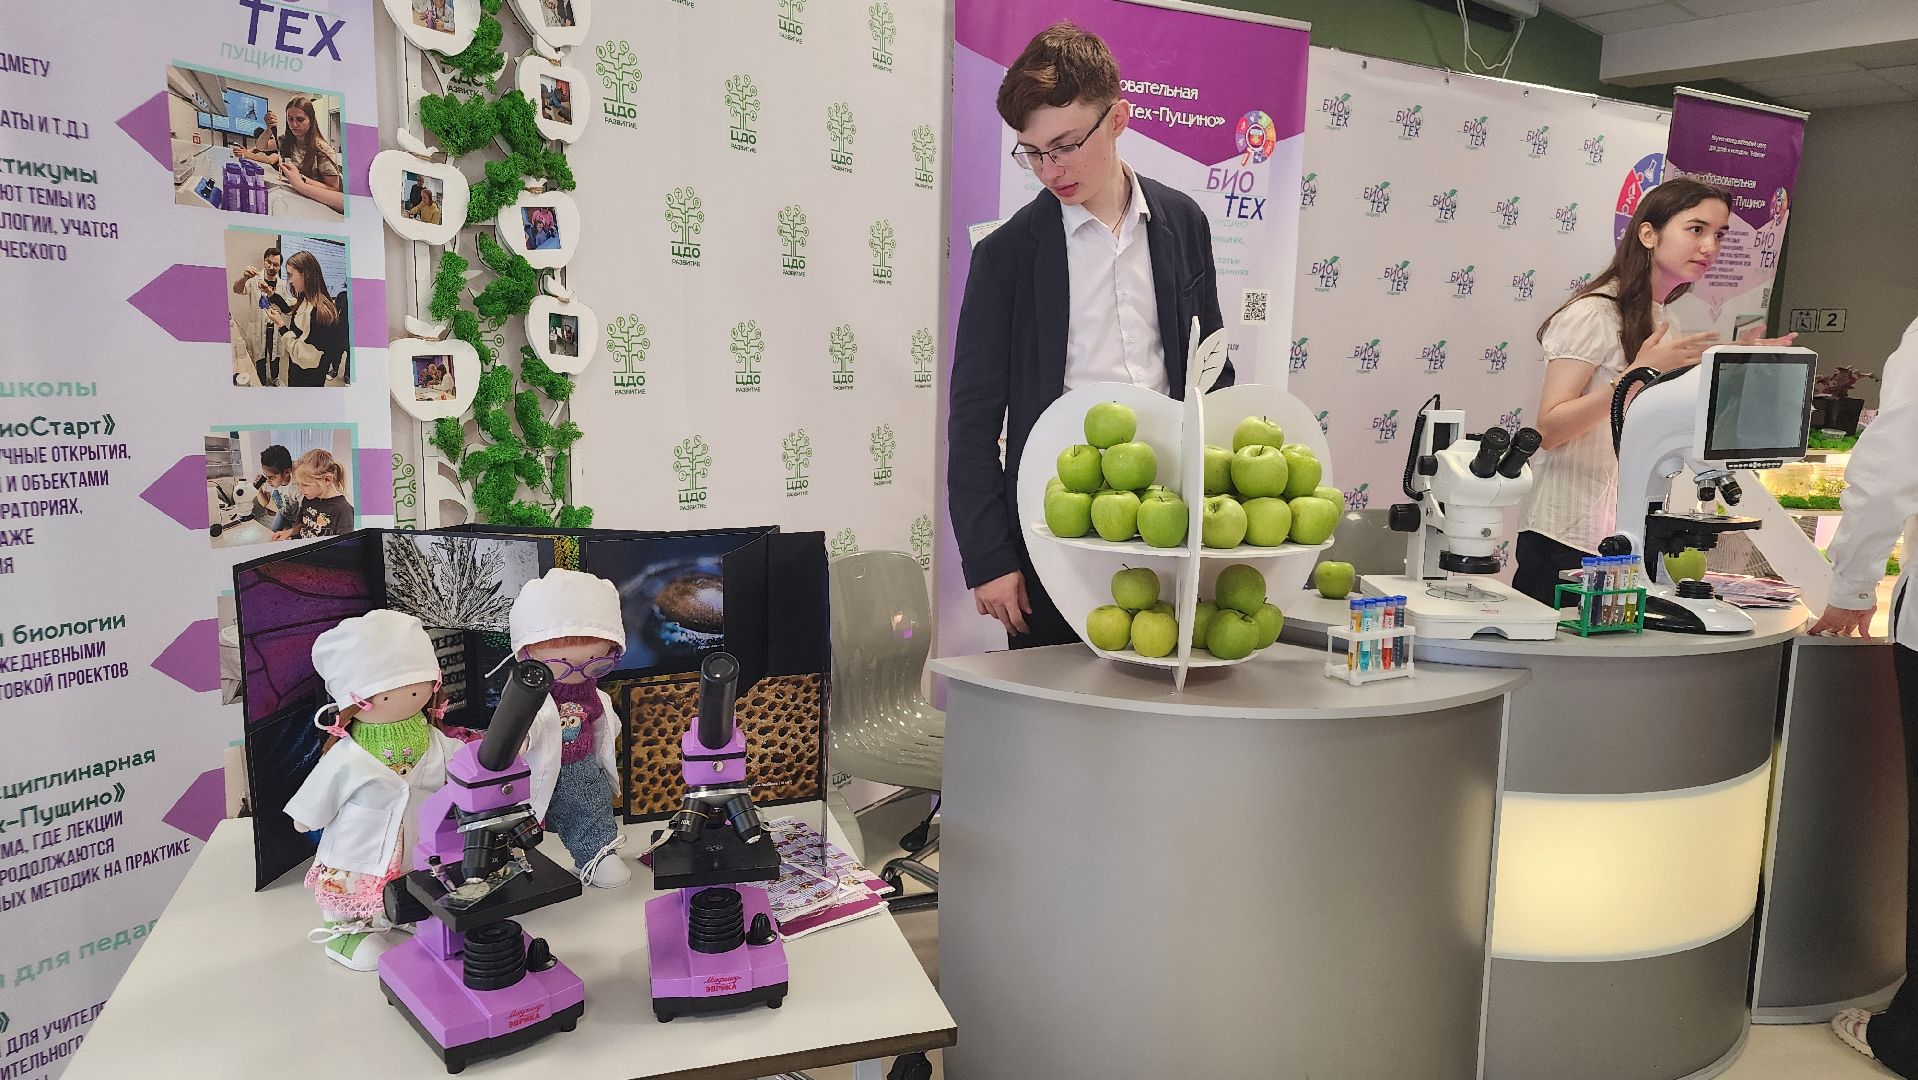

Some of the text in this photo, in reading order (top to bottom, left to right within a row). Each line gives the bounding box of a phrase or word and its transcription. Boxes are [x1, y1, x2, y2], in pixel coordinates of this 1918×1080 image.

[239, 0, 346, 62] ТЕХ
[778, 19, 803, 36] ЦДО
[220, 42, 303, 73] ПУЩИНО
[872, 51, 893, 66] ЦДО
[604, 103, 637, 119] ЦДО
[1, 110, 33, 131] АТЫ
[38, 115, 48, 134] И
[1331, 112, 1350, 127] ТЕХ
[730, 130, 757, 144] ЦДО
[1403, 123, 1420, 138] ТЕХ
[1470, 134, 1486, 147] ТЕХ
[1532, 143, 1547, 155] ТЕХ
[831, 153, 853, 165] ЦДО
[0, 158, 98, 184] тикумы
[915, 172, 933, 183] ЦДО
[1206, 168, 1255, 194] БИО
[28, 187, 73, 209] ТЕМЫ
[77, 193, 96, 210] ИЗ
[1225, 194, 1267, 220] ТЕХ
[1371, 199, 1389, 213] ТЕХ
[1439, 207, 1455, 220] ТЕХ
[1502, 213, 1518, 226] ТЕХ
[60, 218, 119, 239] УЧАТСЯ
[1561, 219, 1575, 231] ТЕХ
[1754, 231, 1775, 248] БИО
[672, 246, 700, 258] ЦДО
[1760, 250, 1777, 268] ТЕХ
[783, 258, 806, 269] ЦДО
[873, 268, 892, 278] ЦДО
[1320, 274, 1337, 288] ТЕХ
[1391, 279, 1408, 291] ТЕХ
[1456, 283, 1473, 295] ТЕХ
[1518, 286, 1533, 298] ТЕХ
[1826, 313, 1838, 327] 2
[1361, 357, 1379, 370] ТЕХ
[1428, 358, 1445, 370] ТЕХ
[1490, 359, 1506, 370] ТЕХ
[614, 376, 645, 387] ЦДО
[736, 375, 760, 385] ЦДО
[833, 375, 853, 384] ЦДО
[915, 374, 931, 382] ЦДО
[1379, 428, 1397, 440] ТЕХ
[0, 444, 131, 465] ЧНЫЕ ОТКРЫТИЯ,
[6, 470, 109, 493] И ОБЪЕКТАМИ
[873, 470, 892, 480] ЦДО
[786, 480, 809, 491] ЦДО
[679, 491, 707, 503] ЦДО
[1, 498, 83, 520] РАТОРИЯХ,
[13, 614, 126, 645] биологии
[58, 661, 129, 690] ПРОЕКТОВ
[0, 749, 156, 799] циплинарная
[33, 828, 61, 850] ГДЕ
[65, 810, 124, 841] ЛЕКЦИИ
[0, 838, 191, 912] ЫХ МЕТОДИК НА ПРАКТИКЕ
[14, 951, 70, 988] для
[6, 1029, 39, 1057] ДЛЯ
